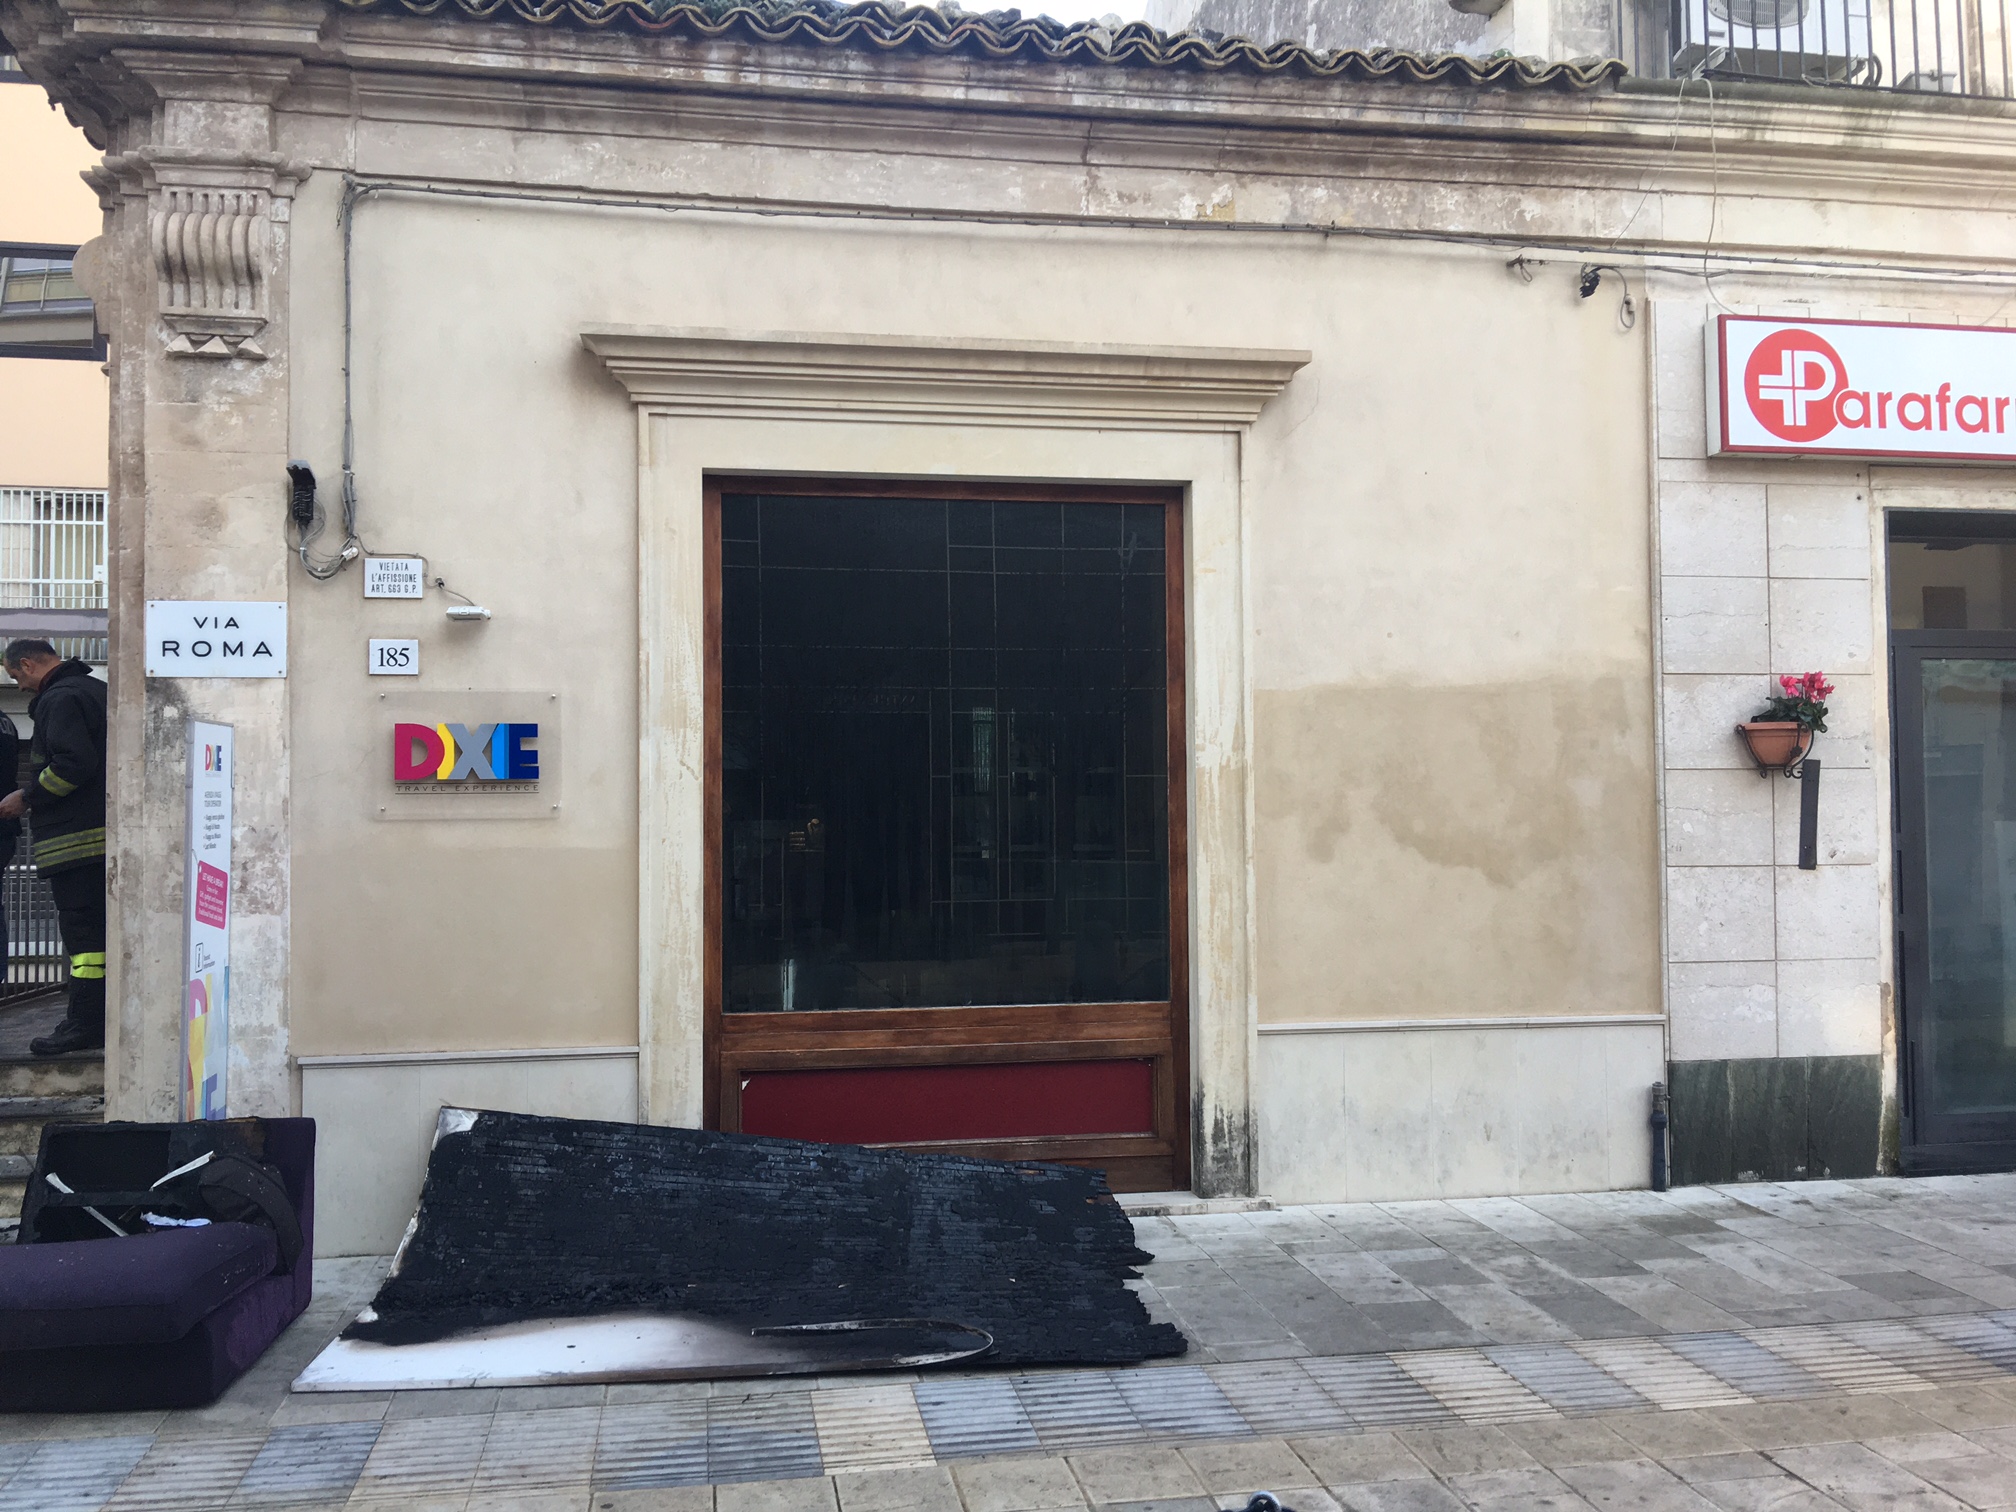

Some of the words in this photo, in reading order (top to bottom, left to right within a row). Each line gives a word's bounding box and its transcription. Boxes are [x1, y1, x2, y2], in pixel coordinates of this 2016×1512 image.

[1759, 349, 2016, 433] Parafar
[379, 562, 409, 571] VIETATA
[371, 573, 417, 582] L'AFFISSIONE
[388, 584, 401, 593] 663
[193, 616, 240, 629] VIA
[162, 640, 273, 657] ROMA
[377, 647, 410, 667] 185
[394, 723, 539, 780] DIXIE
